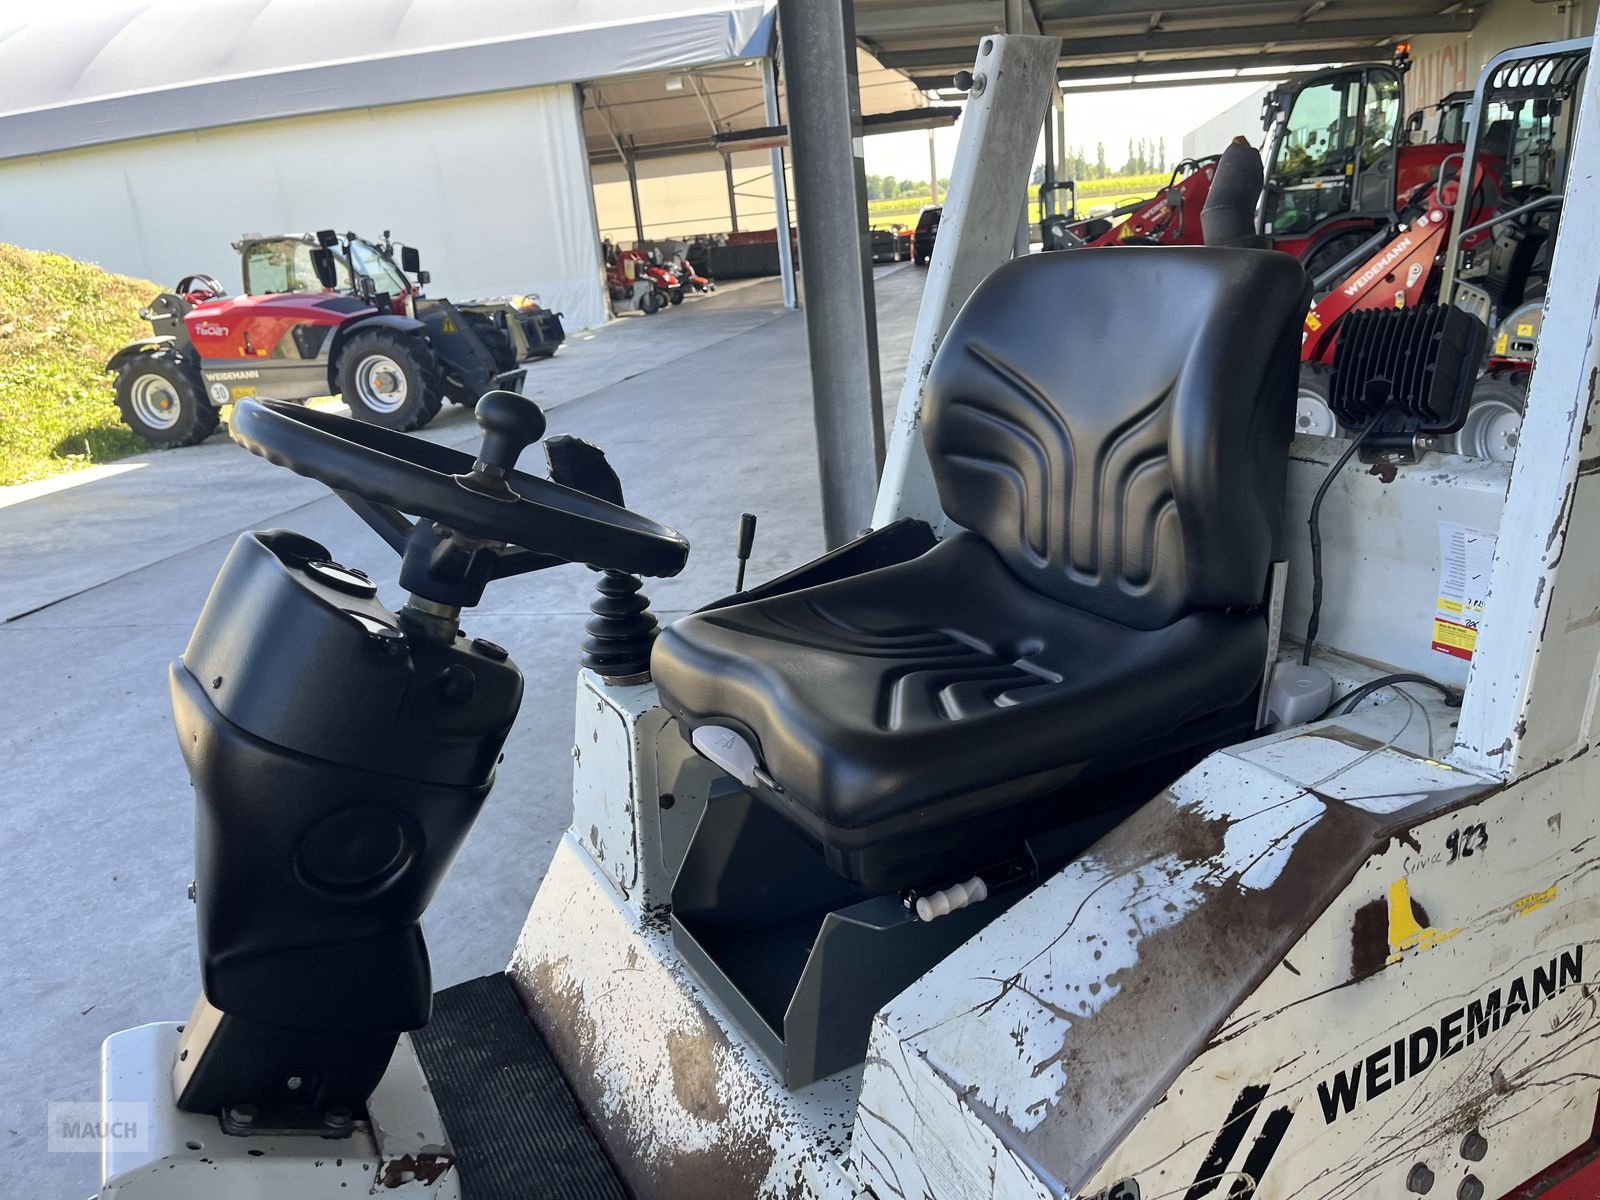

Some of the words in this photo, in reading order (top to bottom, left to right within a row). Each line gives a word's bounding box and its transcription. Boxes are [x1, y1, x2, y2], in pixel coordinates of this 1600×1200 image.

[1343, 237, 1411, 296] WEIDEMANN
[205, 370, 259, 381] WEIDEMANN
[213, 386, 227, 399] 30
[1316, 944, 1583, 1126] WEIDEMANN
